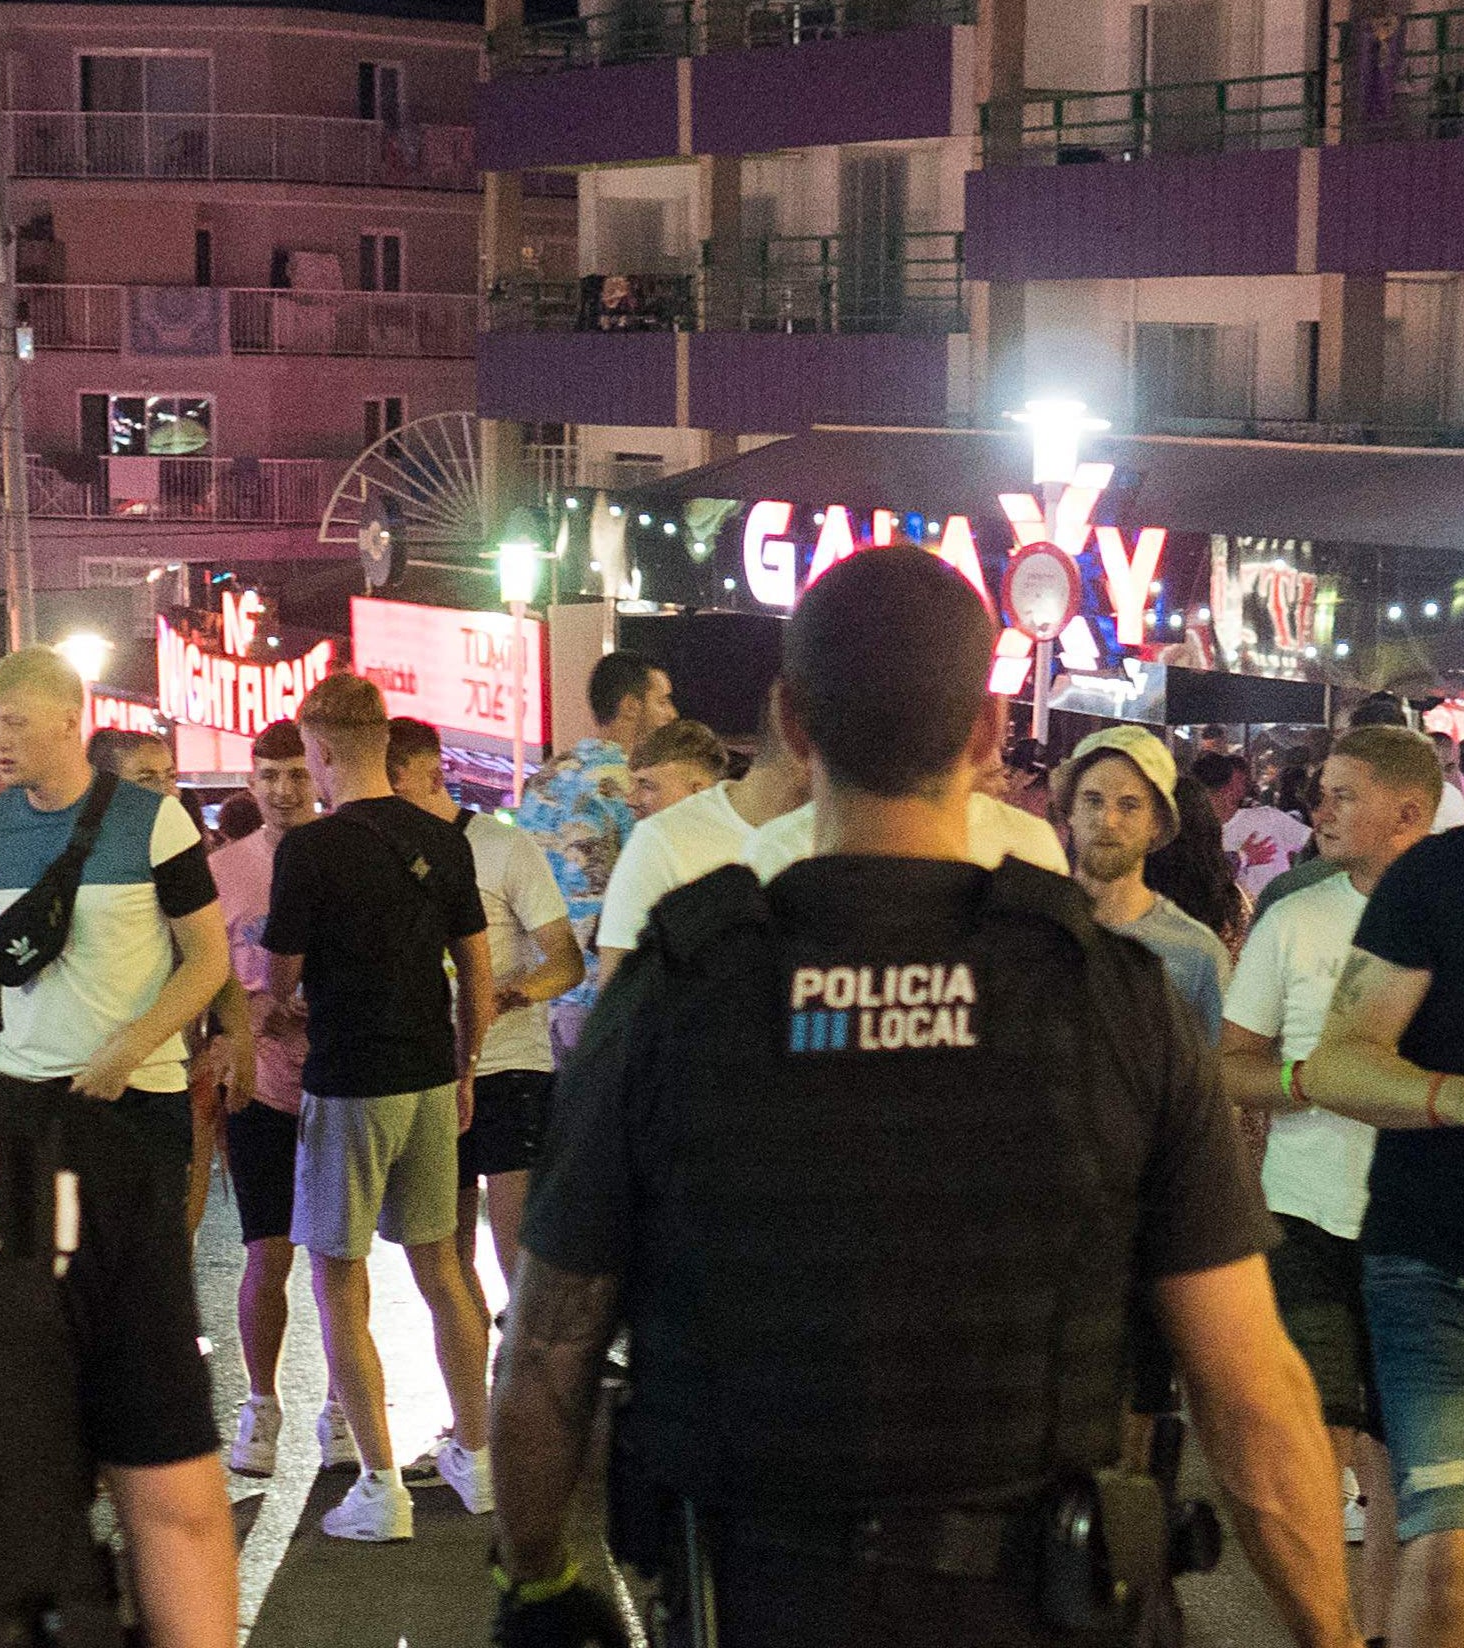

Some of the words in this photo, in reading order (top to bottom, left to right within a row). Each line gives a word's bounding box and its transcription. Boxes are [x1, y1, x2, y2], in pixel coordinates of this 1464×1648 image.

[157, 613, 236, 731] NIGHT
[790, 963, 976, 1009] POLICIA
[858, 1005, 977, 1050] LOCAL
